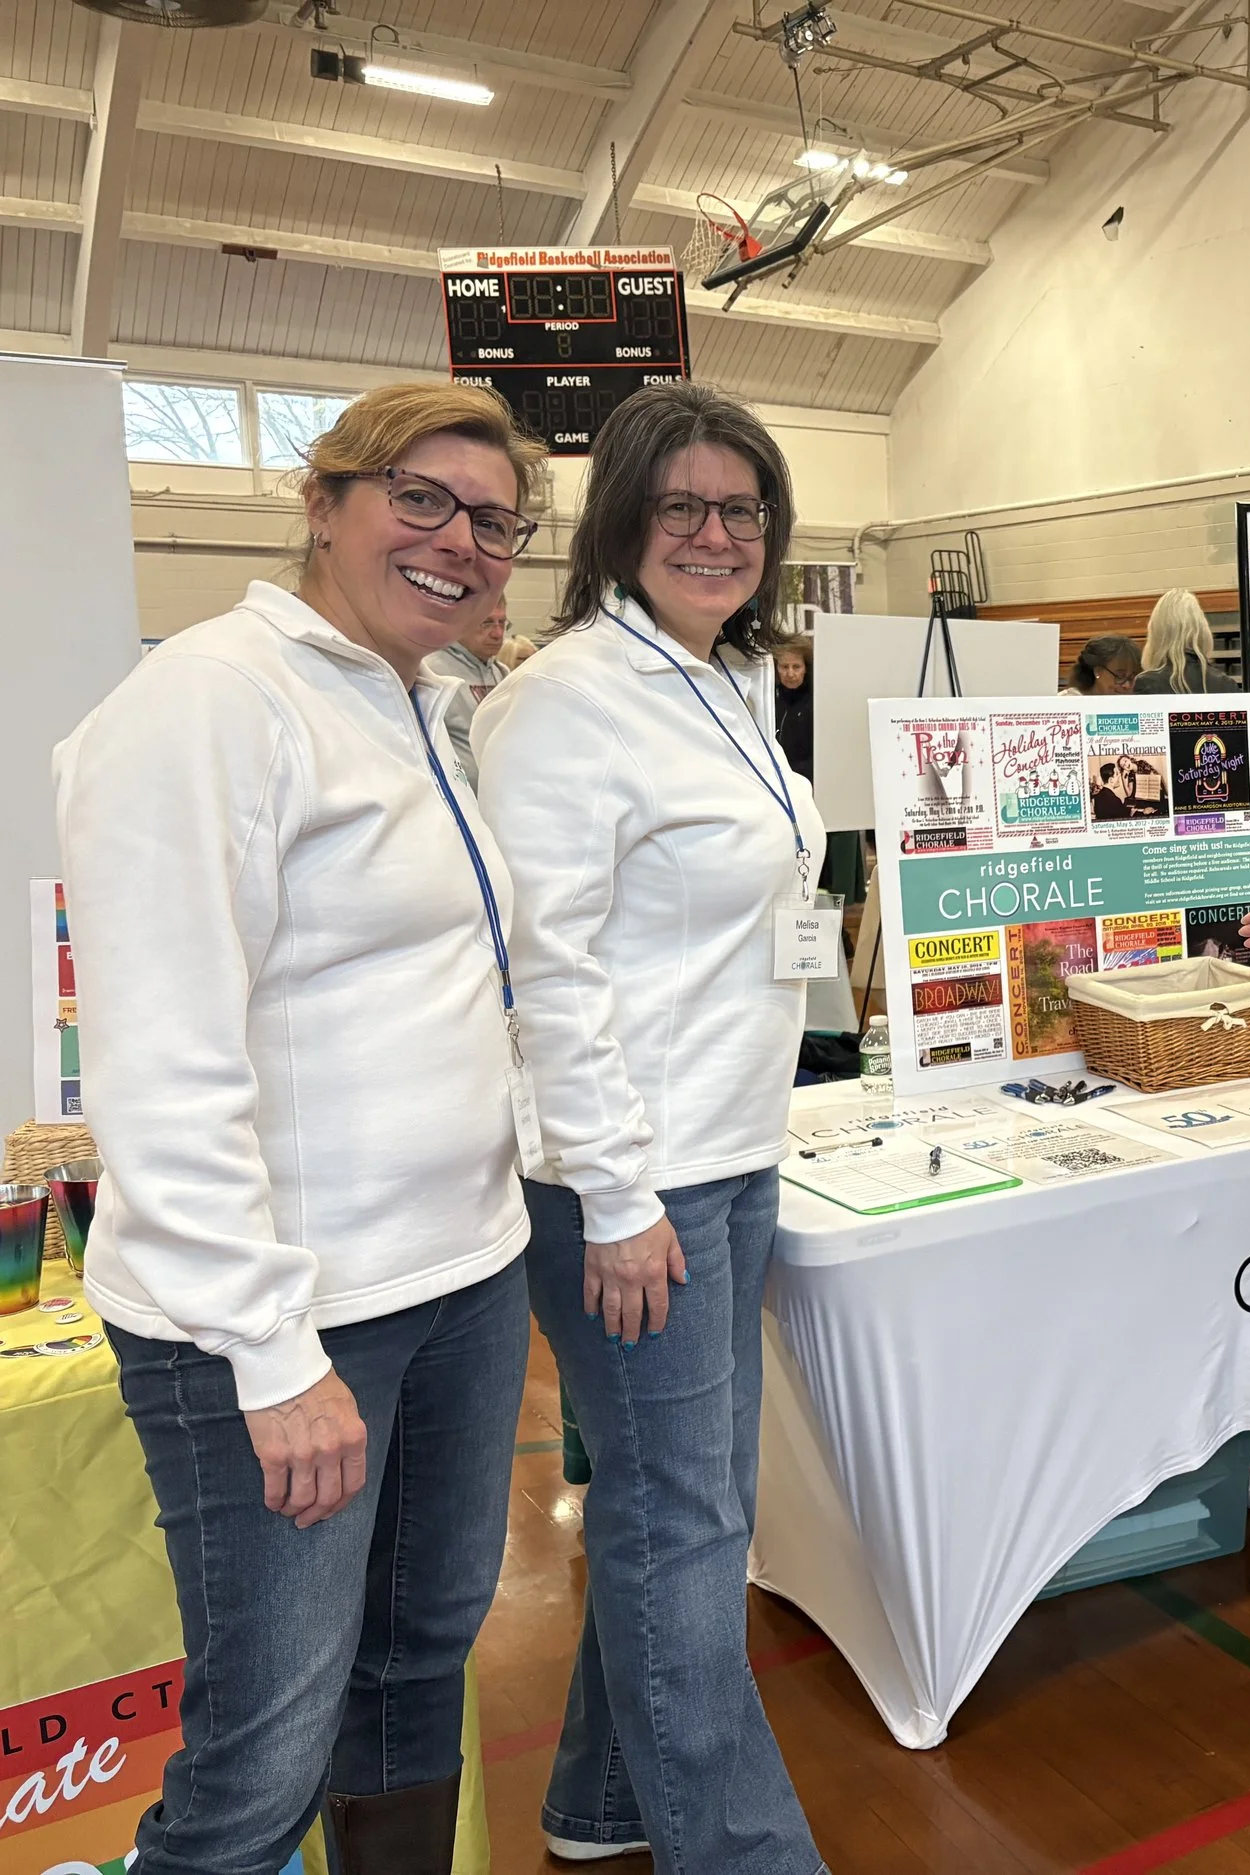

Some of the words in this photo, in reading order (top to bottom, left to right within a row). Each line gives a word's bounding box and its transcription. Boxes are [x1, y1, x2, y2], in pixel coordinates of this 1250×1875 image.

[539, 250, 600, 266] Basketball
[603, 250, 670, 265] Association
[447, 278, 500, 297] HOME
[618, 277, 674, 295] GUEST
[545, 322, 579, 331] PERIOD
[478, 349, 514, 359] BONUS
[615, 347, 651, 358] BONUS
[453, 377, 492, 387] FOULS
[546, 376, 591, 387] PLAYER
[643, 375, 682, 385] FOULS
[554, 433, 589, 444] GAME
[1015, 719, 1040, 727] December
[1098, 717, 1138, 725] RIDGEFIELD
[1169, 712, 1247, 722] CONCERT
[1098, 724, 1129, 732] CHORALE
[942, 732, 956, 748] the
[1046, 724, 1081, 747] Pops
[992, 730, 1048, 764] Holiday
[1098, 743, 1120, 756] Fine
[1122, 743, 1167, 755] Romance
[910, 732, 969, 777] Prom
[1054, 751, 1080, 759] Ridgefield
[1004, 745, 1056, 778] Concert!
[1178, 764, 1221, 784] Saturday
[1020, 795, 1080, 808] RIDGEFIELD
[1020, 806, 1067, 818] CHORALE
[1092, 822, 1116, 830] Saturday,
[1134, 820, 1147, 828] 2012
[1185, 816, 1225, 825] RIDGEFIELD
[1186, 823, 1217, 832] CHORALE
[915, 831, 965, 842] RIDGEFIELD
[915, 840, 955, 849] CHORALE
[1142, 846, 1168, 855] Come
[1169, 843, 1188, 855] sing
[1189, 841, 1209, 852] with
[1211, 841, 1223, 850] us!
[980, 854, 1073, 879] ridgefield
[938, 877, 1105, 920] CHORALE
[795, 919, 819, 930] Melisa
[1102, 911, 1180, 927] CONCERT
[1114, 931, 1155, 941] RIDGEFIELD
[914, 934, 994, 959] CONCERT
[1115, 939, 1146, 949] CHORALE
[1065, 943, 1094, 960] The
[791, 961, 822, 970] CHORALE
[1060, 959, 1095, 977] Road
[914, 979, 1000, 1011] BROADWAY!
[1009, 930, 1025, 1055] CONCERT
[930, 1046, 971, 1057] RIDGEFIELD
[931, 1053, 961, 1064] CHORALE
[848, 1105, 949, 1125] ridgefield
[811, 1106, 998, 1139] CHORALE
[111, 1680, 173, 1721] CT
